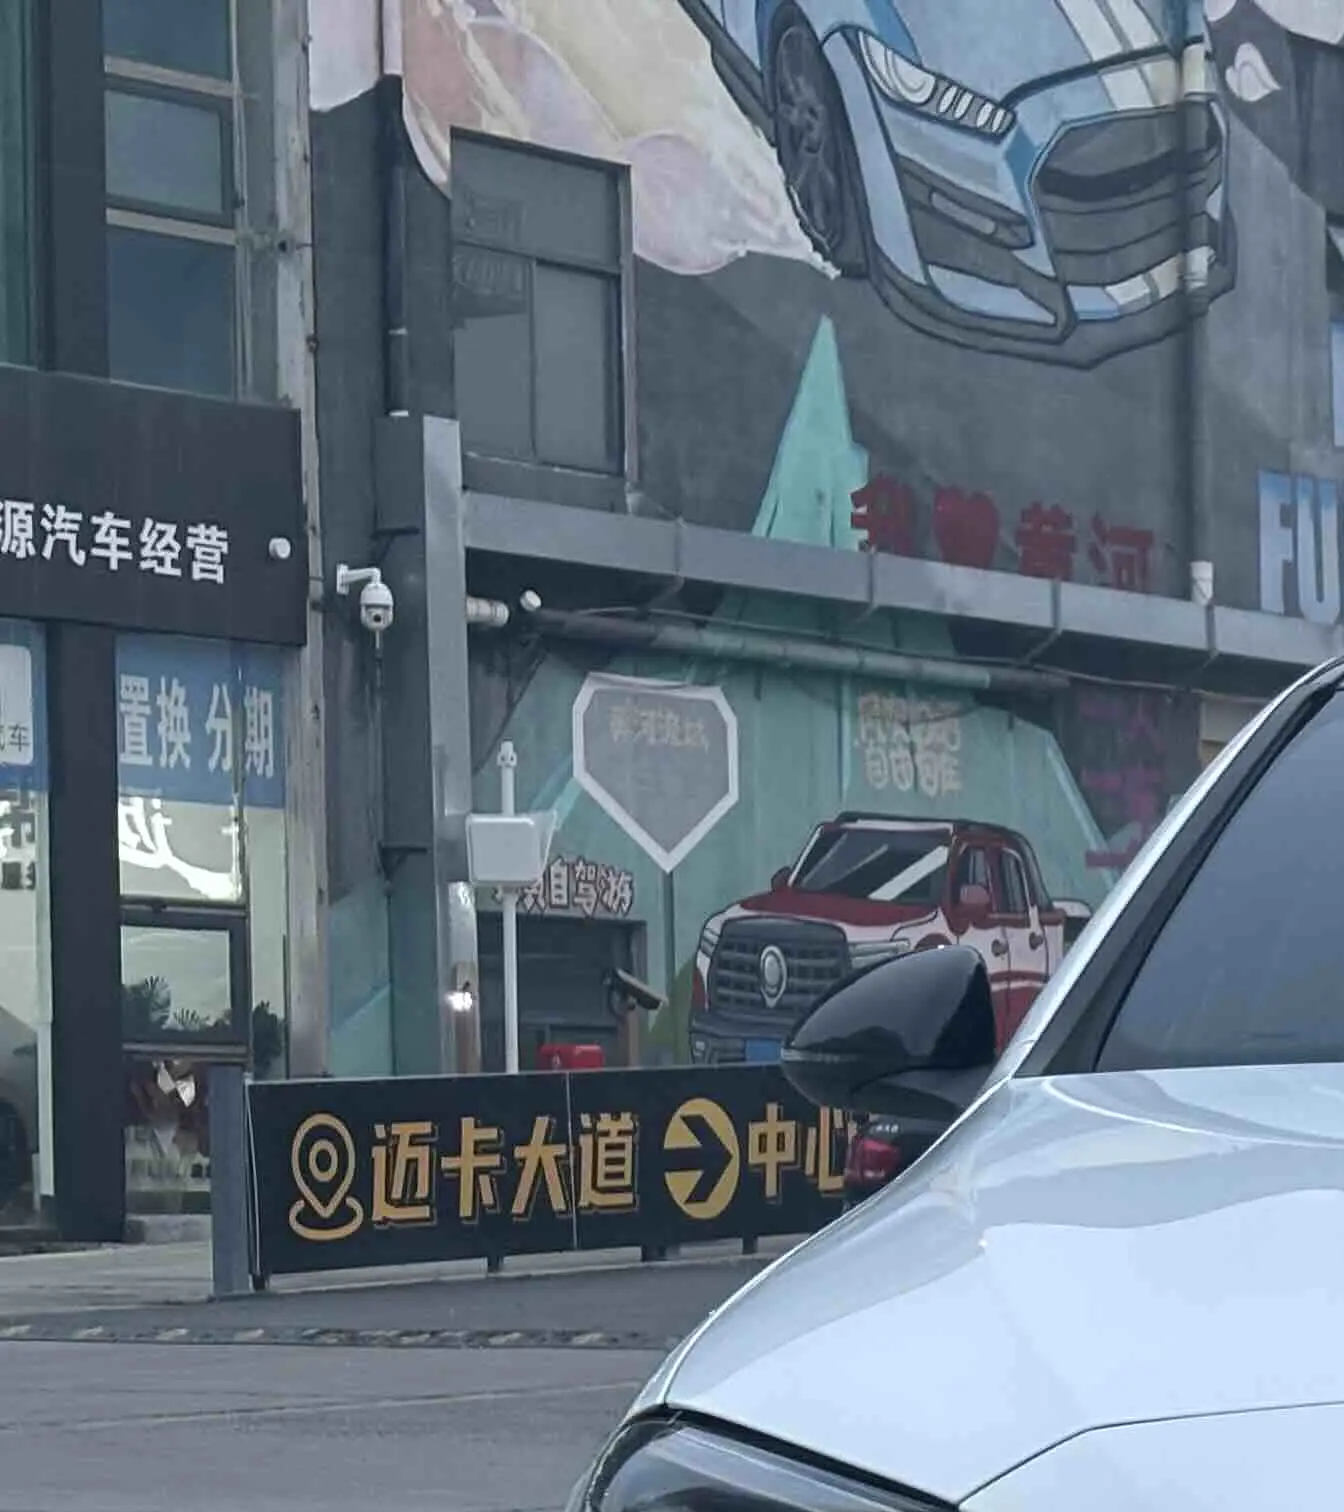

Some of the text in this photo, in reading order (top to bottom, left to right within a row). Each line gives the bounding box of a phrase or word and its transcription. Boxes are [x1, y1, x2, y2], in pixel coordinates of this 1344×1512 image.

[0, 499, 229, 584] 源汽车经营
[371, 1112, 644, 1226] 迈卡大道
